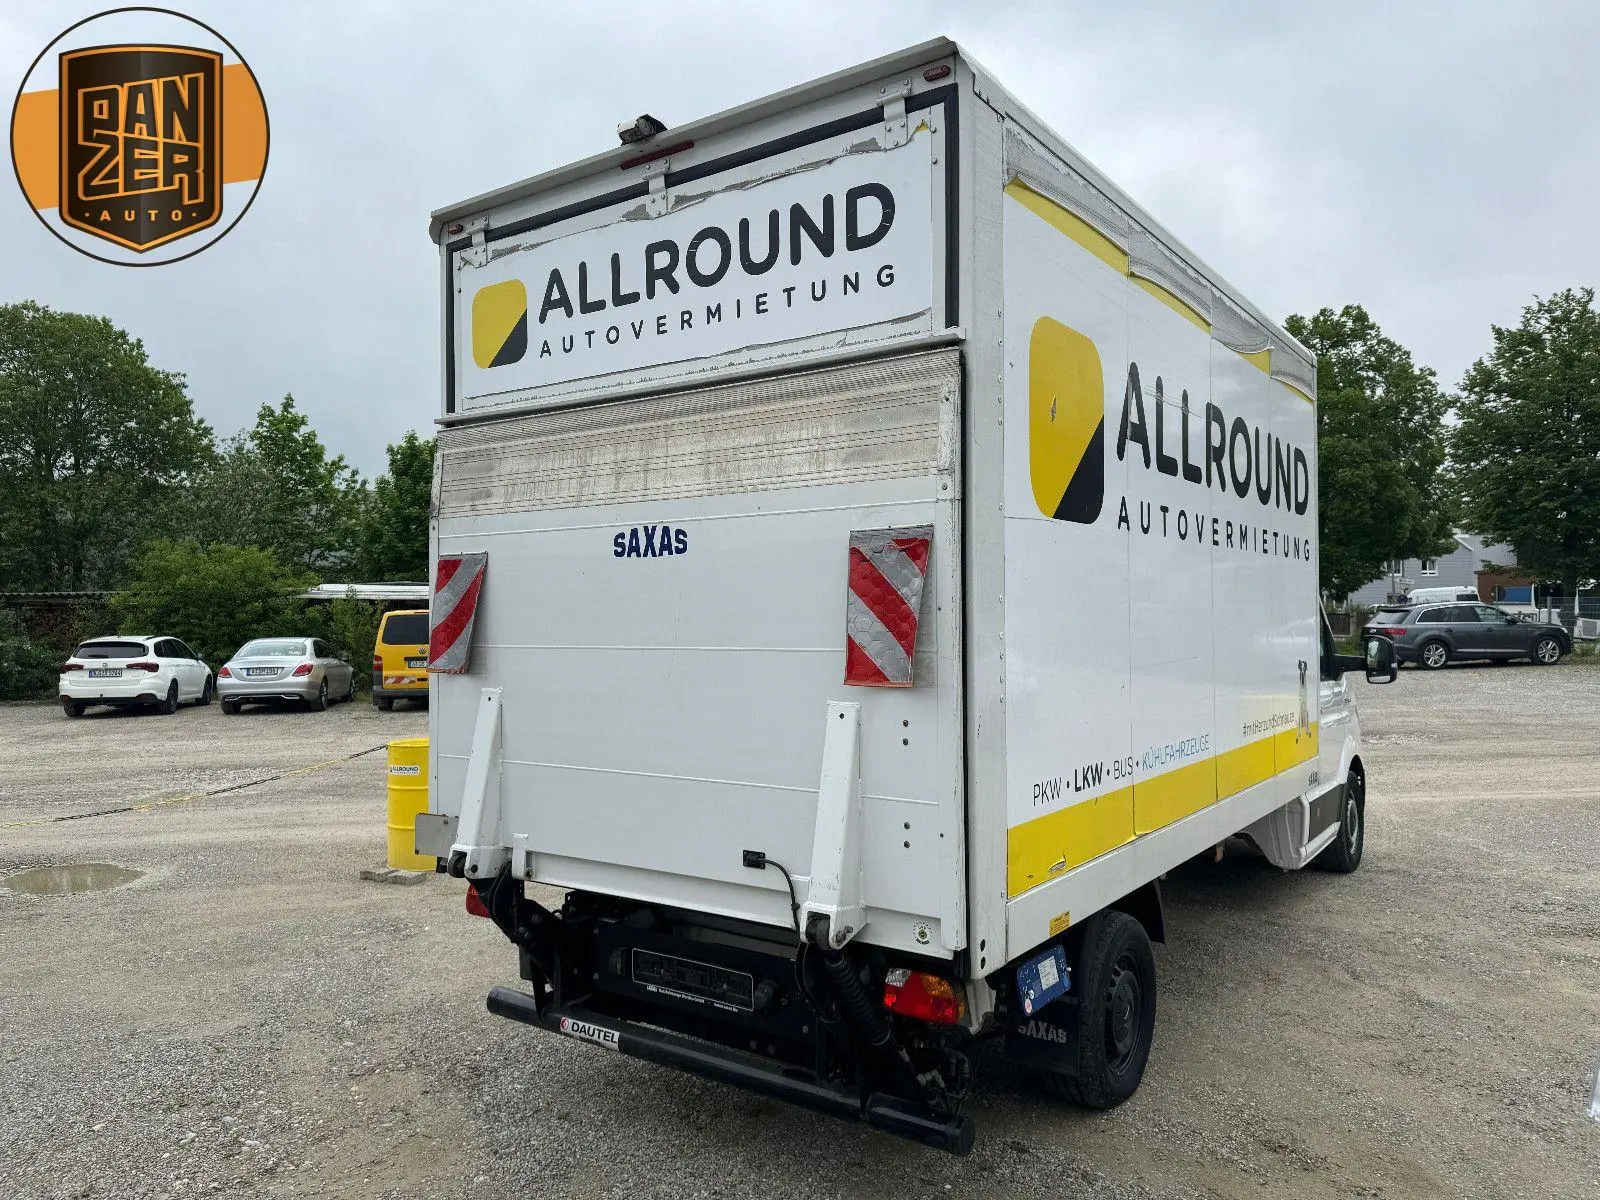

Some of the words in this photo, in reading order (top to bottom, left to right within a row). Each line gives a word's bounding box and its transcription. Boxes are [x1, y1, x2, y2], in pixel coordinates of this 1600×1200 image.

[538, 182, 896, 324] ALLROUND
[540, 264, 895, 358] AUTOVERMIETUNG
[1117, 362, 1309, 515] ALLROUND
[613, 525, 688, 558] SAXAS
[1117, 496, 1310, 561] AUTOVERMIETUNG
[1033, 776, 1062, 806] PKW
[1074, 761, 1103, 793] LKW
[1113, 756, 1133, 780] BUS
[1142, 734, 1210, 771] KÜHLFAHRZEUGE
[571, 1021, 618, 1044] DAUTEL
